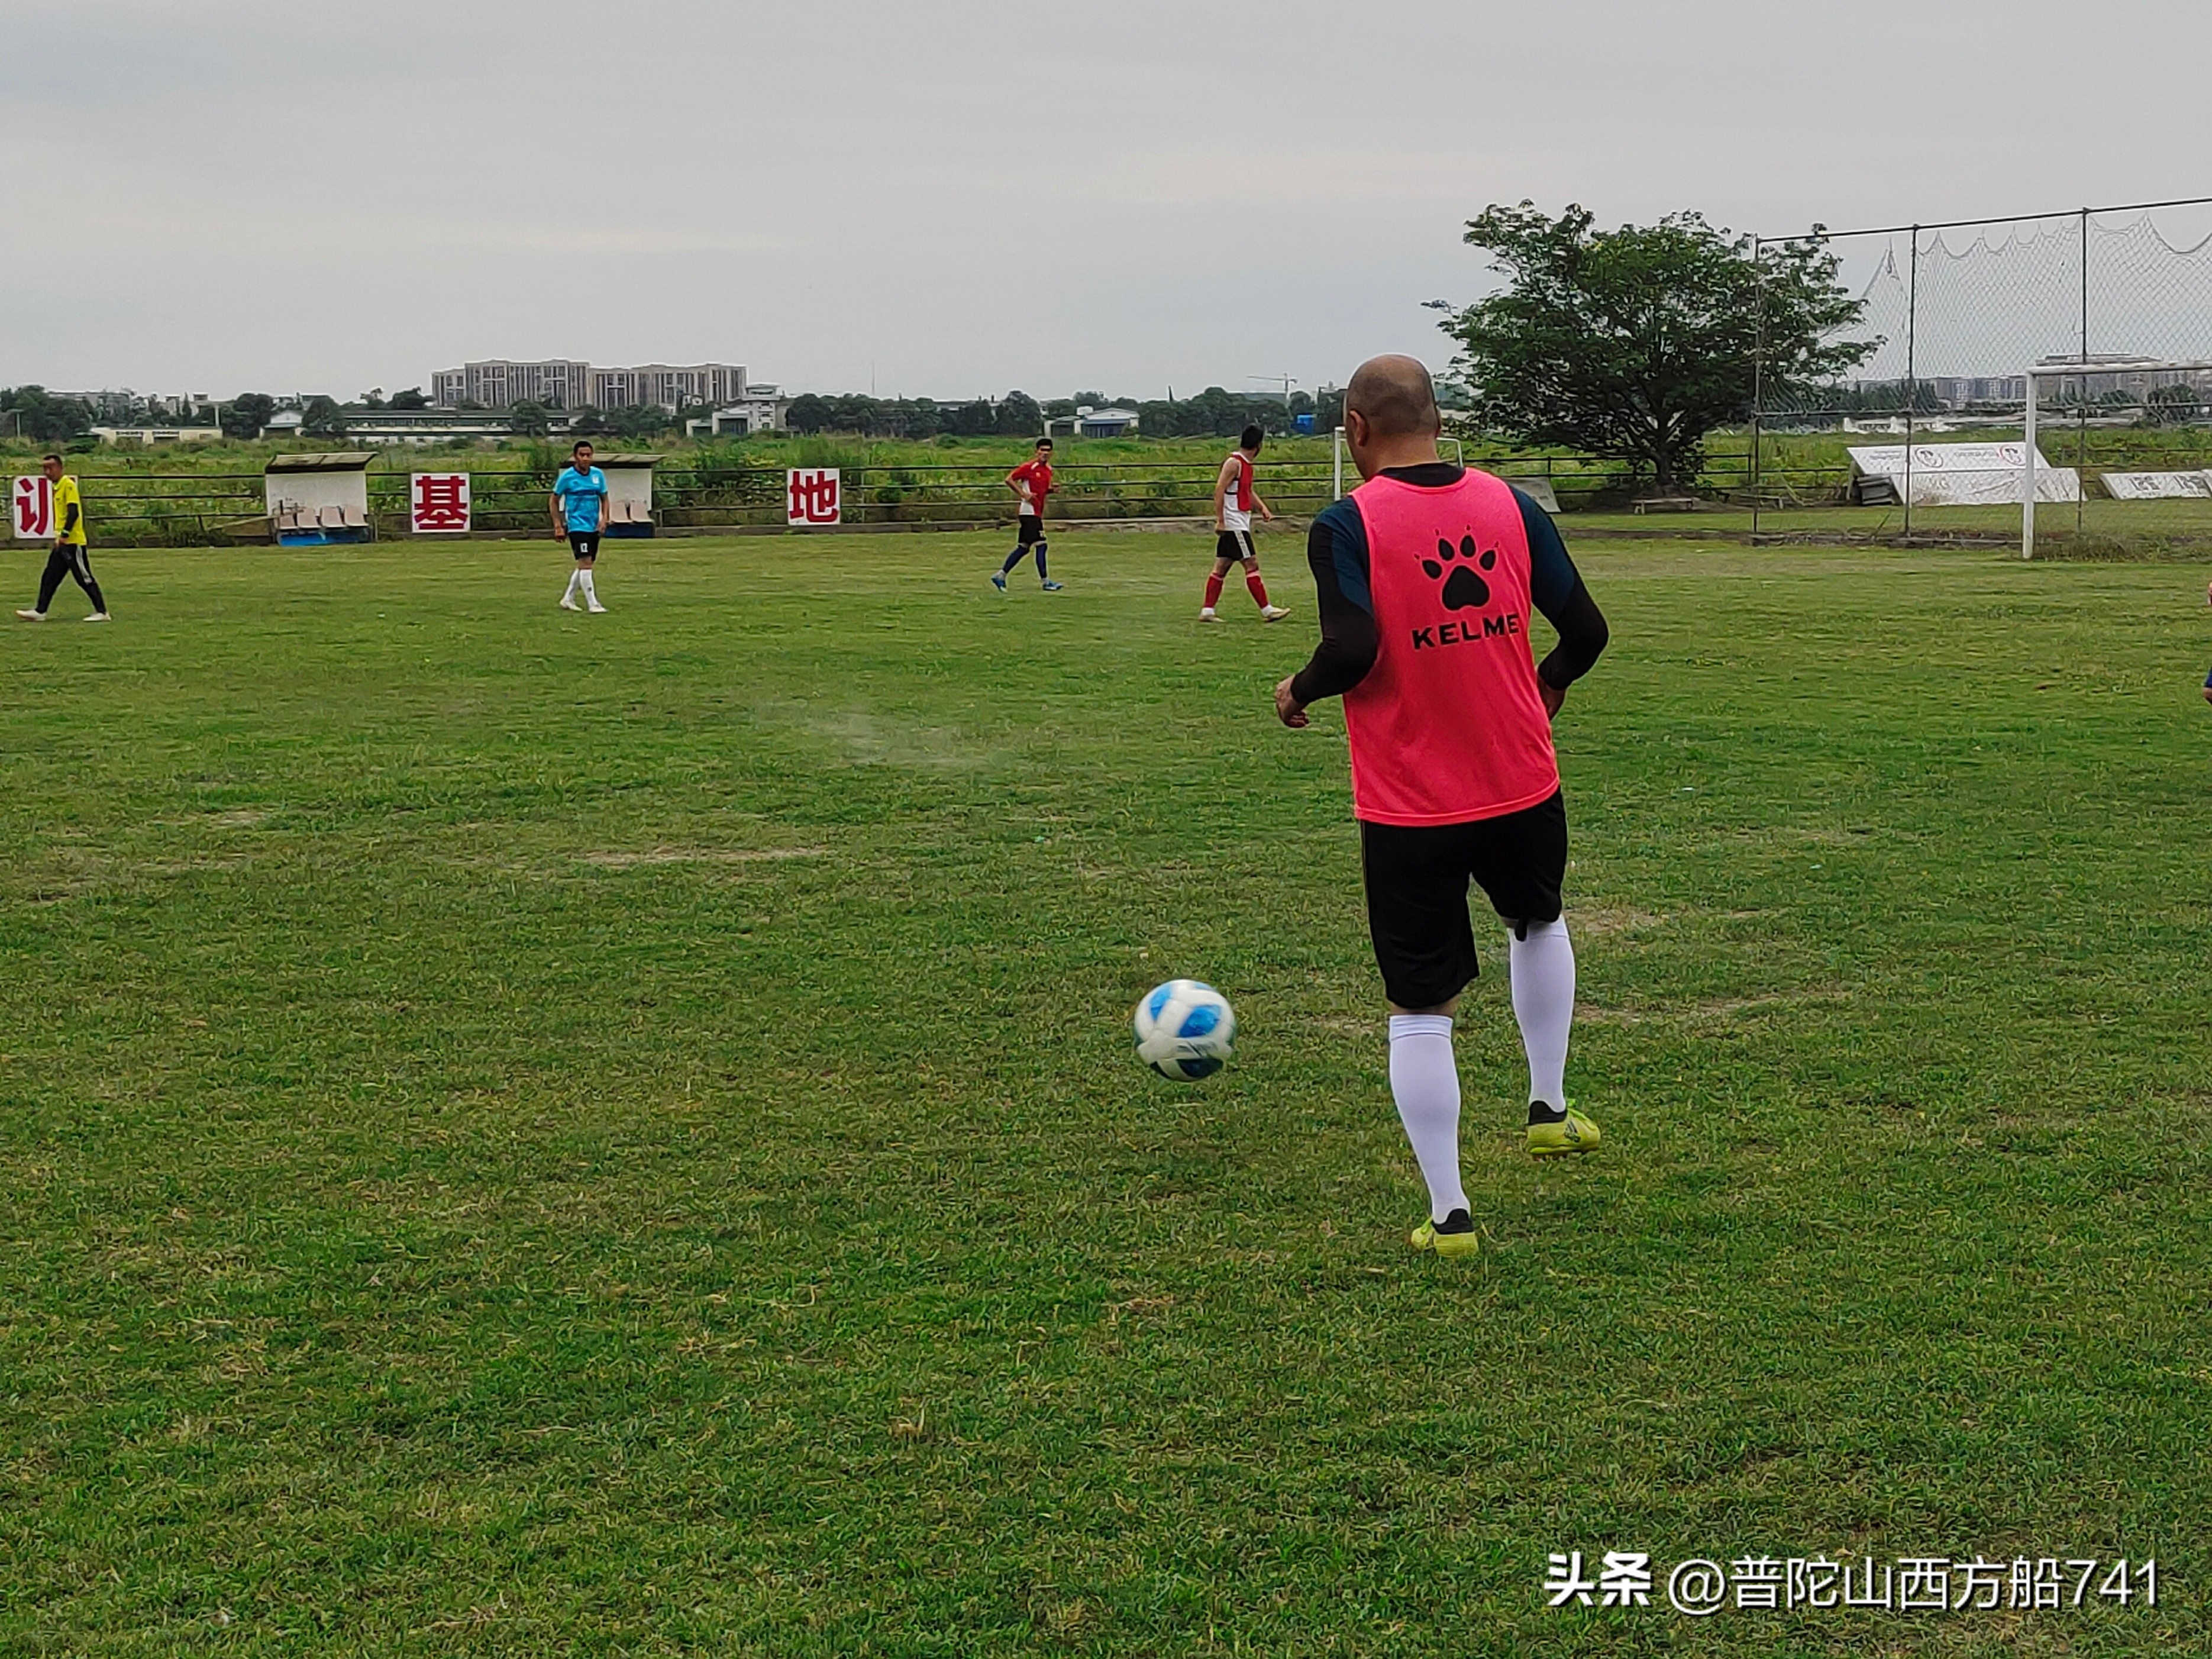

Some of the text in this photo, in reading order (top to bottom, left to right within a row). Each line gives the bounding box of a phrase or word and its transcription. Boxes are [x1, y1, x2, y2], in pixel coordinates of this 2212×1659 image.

[414, 476, 468, 530] 基
[789, 471, 838, 522] 地
[1412, 613, 1519, 650] KELME
